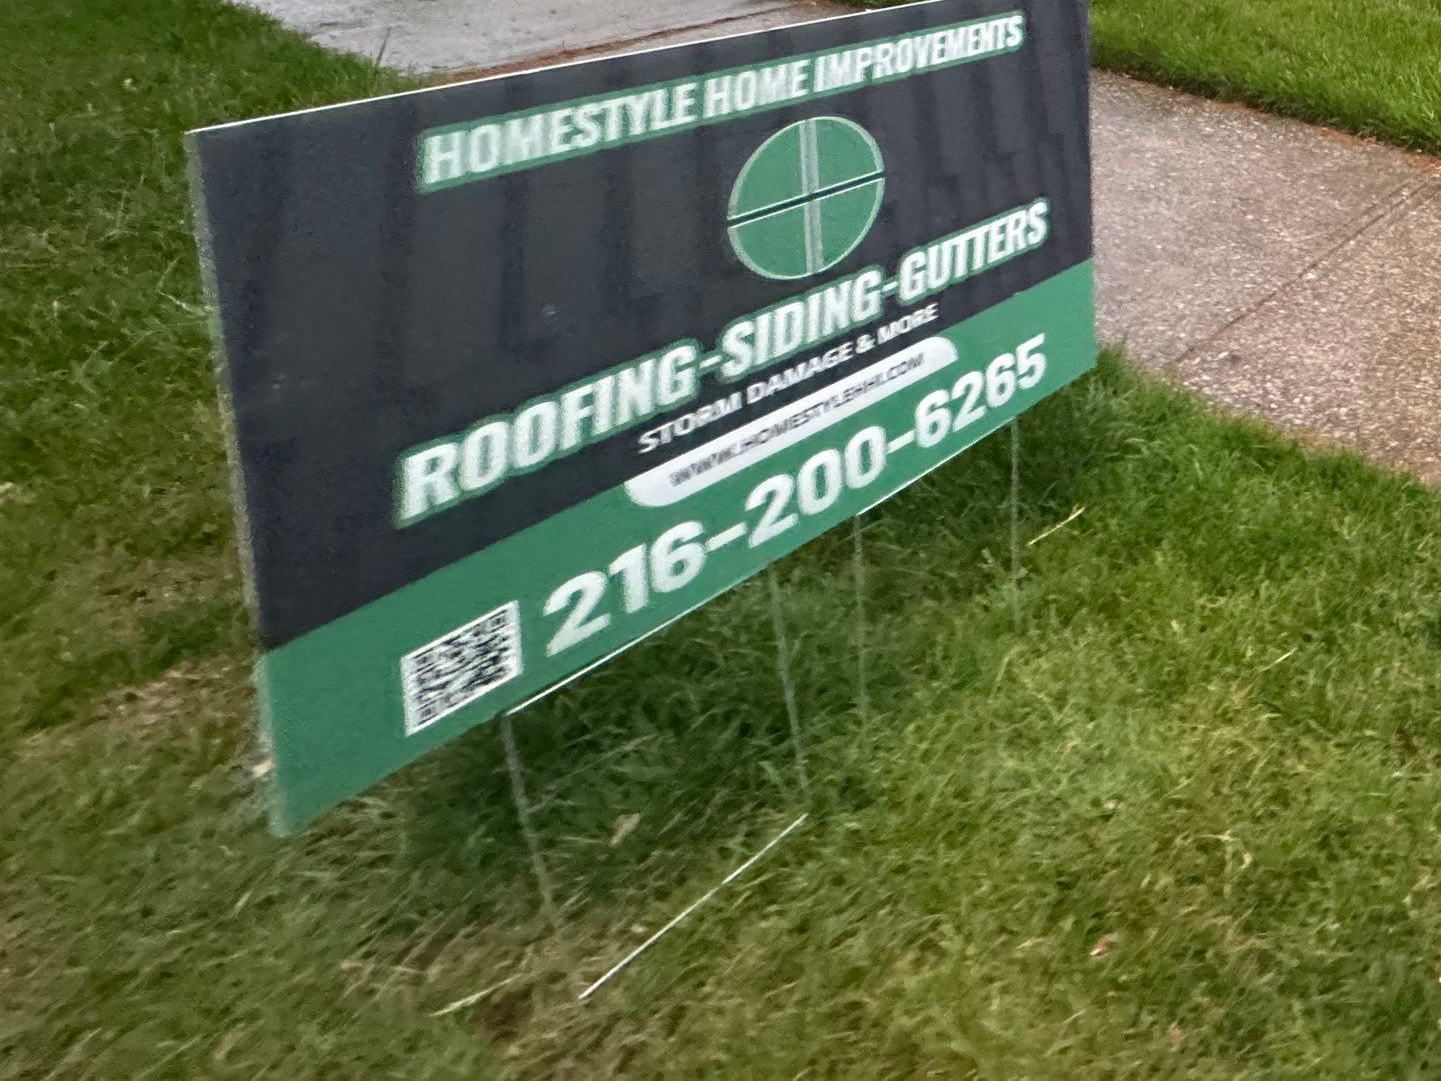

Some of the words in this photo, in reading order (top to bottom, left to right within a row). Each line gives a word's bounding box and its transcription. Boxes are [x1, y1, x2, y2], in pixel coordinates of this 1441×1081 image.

[423, 83, 698, 184] HOMESTYLE
[703, 60, 809, 118] HOME
[813, 15, 1024, 93] IMPROVEMENTS
[399, 201, 1049, 521] ROOFING-SIDING-GUTTERS
[637, 391, 743, 454] STORM
[746, 341, 855, 405] DAMAGE
[854, 333, 876, 355] &
[877, 303, 939, 345] MORE
[543, 333, 1048, 657] 216-200-6265
